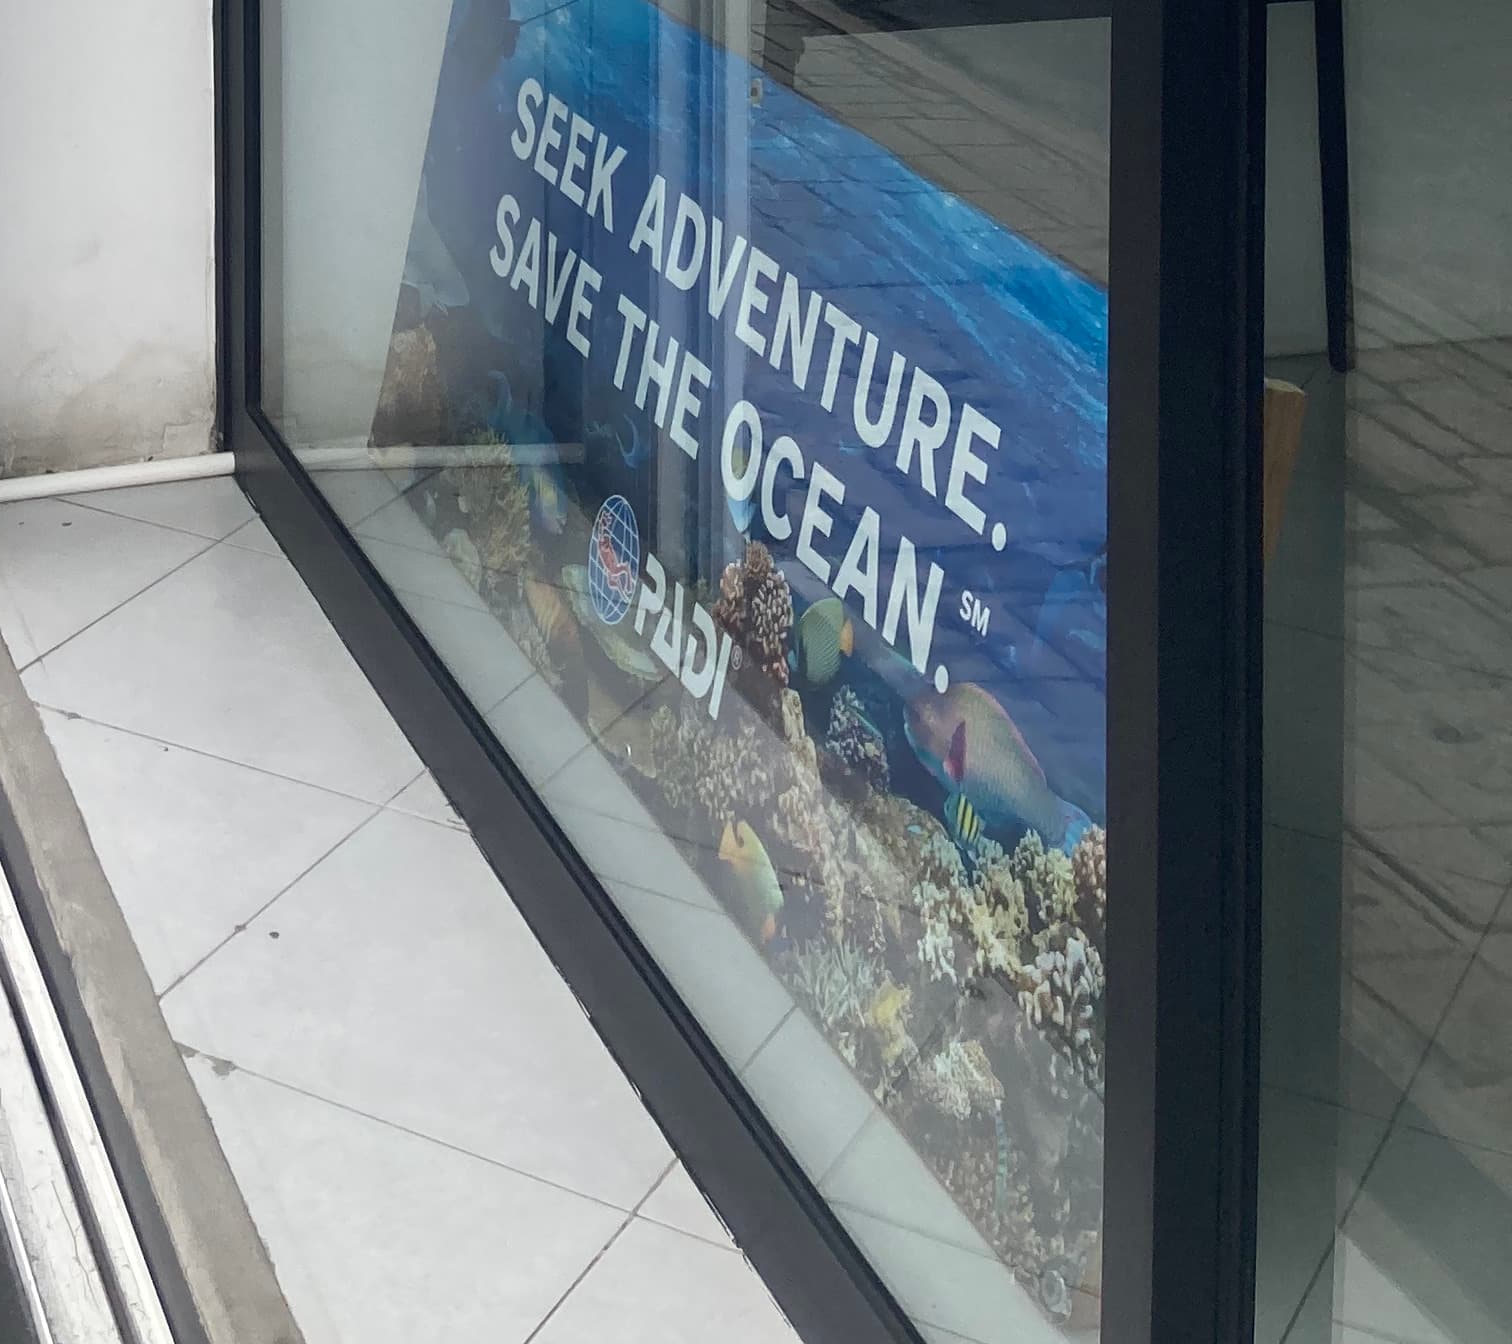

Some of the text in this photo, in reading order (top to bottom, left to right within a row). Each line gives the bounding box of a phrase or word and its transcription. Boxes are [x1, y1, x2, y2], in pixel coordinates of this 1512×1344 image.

[489, 194, 602, 359] SAVE
[612, 296, 713, 460] THE
[720, 399, 950, 694] OCEAN.
[510, 77, 1008, 552] SEEK ADVENTURE.
